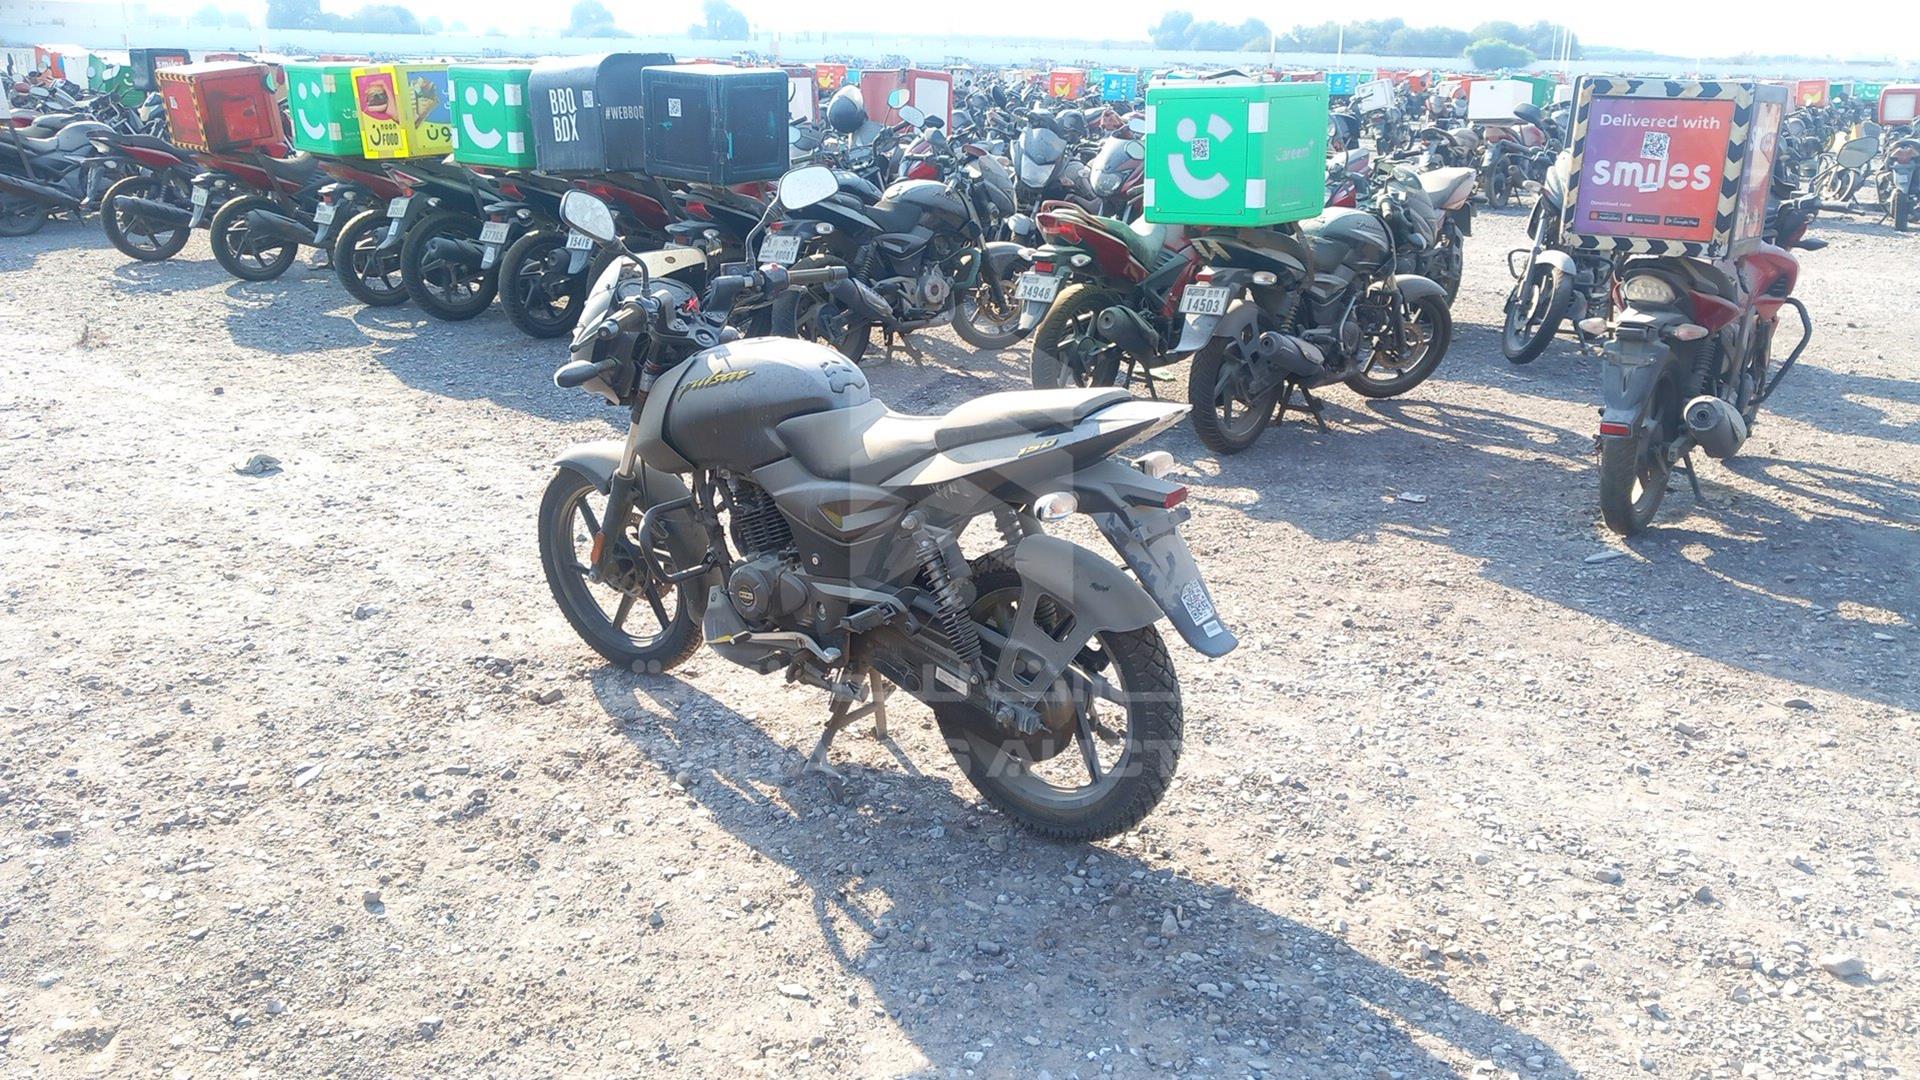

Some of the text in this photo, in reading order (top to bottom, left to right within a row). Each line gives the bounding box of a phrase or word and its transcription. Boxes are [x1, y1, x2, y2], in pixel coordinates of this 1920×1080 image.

[548, 87, 578, 115] BBQ
[551, 113, 580, 142] BOX
[1600, 113, 1721, 130] Delivered with
[382, 132, 400, 146] FOOD
[1591, 142, 1711, 191] smiles
[1187, 298, 1220, 312] 14503
